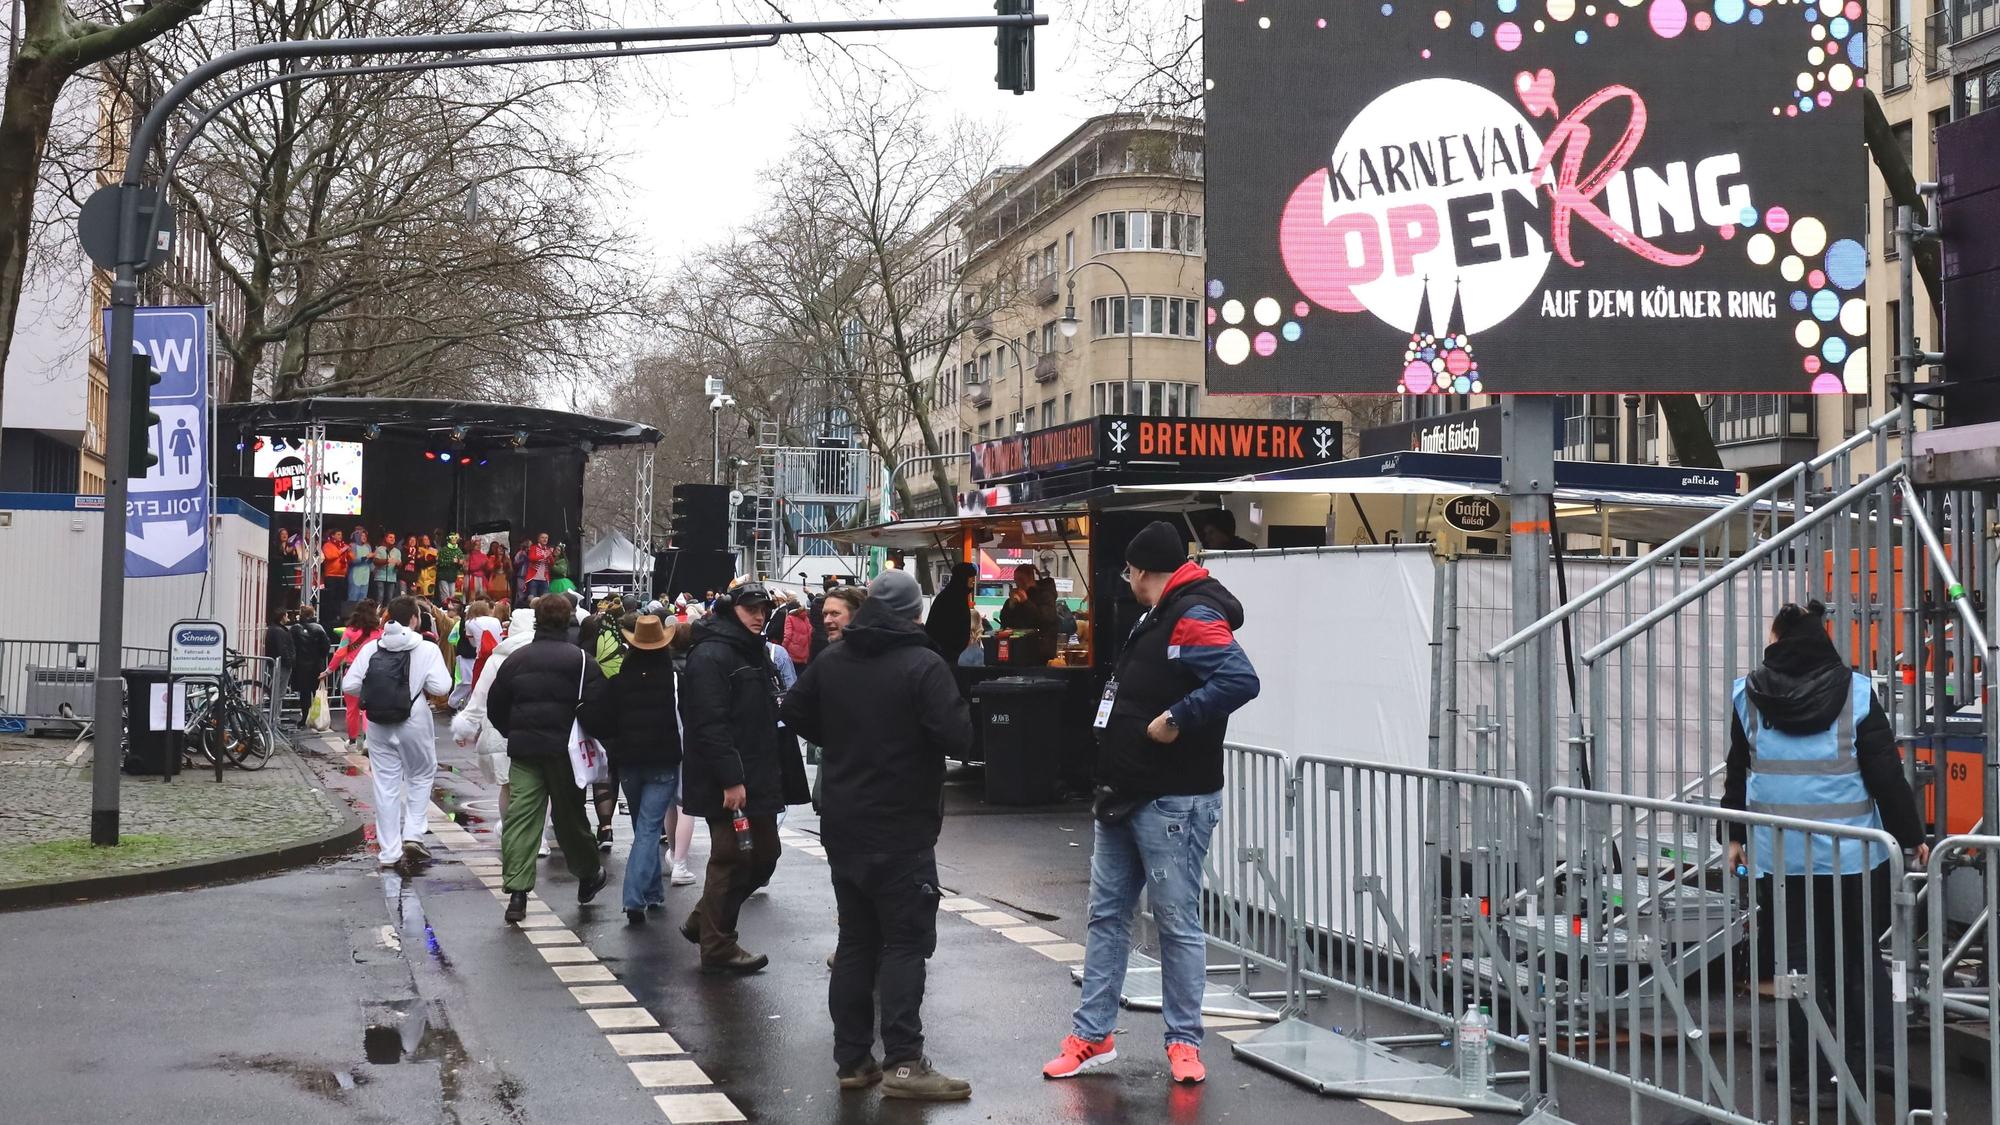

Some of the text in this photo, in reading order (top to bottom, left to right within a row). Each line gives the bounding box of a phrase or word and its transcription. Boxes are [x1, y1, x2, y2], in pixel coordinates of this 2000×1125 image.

[1328, 123, 1541, 203] KARNEVAL
[1324, 187, 1554, 286] OPEN
[1541, 284, 1777, 319] AUF DEM KÖLNER RING
[1031, 423, 1093, 468] HOLZKOHLEGRILL
[1139, 421, 1305, 459] BRENNWERK
[1420, 419, 1480, 453] Gaffel Kölsch
[1681, 475, 1720, 486] gaffel.de
[1455, 500, 1491, 517] Gaffel
[1461, 515, 1484, 526] Kölsch
[180, 631, 218, 643] Schneider
[1946, 762, 1967, 781] 69
